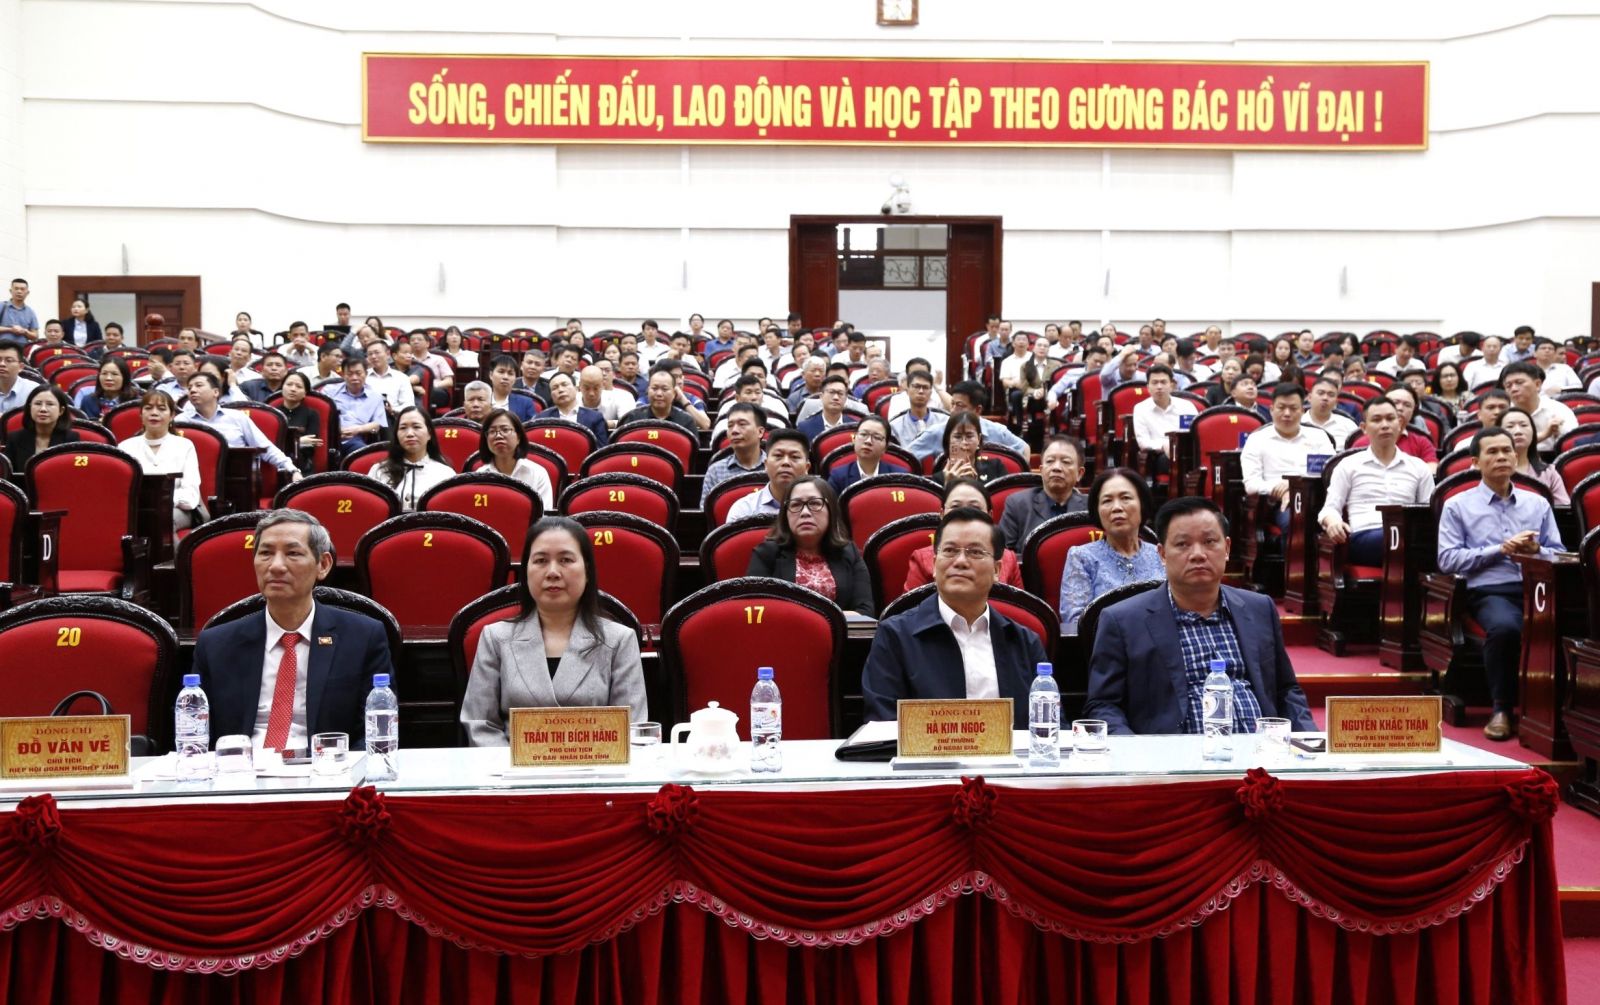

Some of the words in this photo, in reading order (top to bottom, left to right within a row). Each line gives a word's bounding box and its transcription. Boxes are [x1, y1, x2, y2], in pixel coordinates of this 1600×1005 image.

[409, 68, 496, 130] SỐNG,
[504, 69, 591, 127] CHIẾN
[598, 70, 665, 131] ĐẤU,
[673, 85, 726, 127] LAO
[734, 76, 812, 136] ĐỘNG
[820, 77, 856, 127] VÀ
[865, 86, 921, 138] HỌC
[929, 78, 983, 138] TẬP
[990, 87, 1060, 129] THEO
[1069, 84, 1164, 130] GƯƠNG
[1173, 80, 1229, 131] BÁC
[1237, 75, 1274, 132] HỒ
[1283, 81, 1311, 132] VĨ
[1317, 90, 1365, 141] ĐẠI
[1374, 90, 1383, 133] !
[444, 428, 458, 438] 22
[544, 428, 557, 439] 21
[647, 429, 659, 440] 20
[74, 455, 89, 467] 23
[474, 494, 489, 508] 21
[608, 490, 626, 503] 20
[890, 490, 905, 502] 18
[1294, 492, 1302, 514] G
[337, 500, 353, 514] 22
[423, 532, 433, 547] 2
[594, 530, 614, 546] 20
[1390, 526, 1400, 550] D
[43, 534, 51, 561] D
[1534, 582, 1546, 612] C
[744, 605, 765, 624] 17
[56, 627, 82, 647] 20
[926, 719, 939, 734] HÀ
[940, 722, 959, 734] KIM
[961, 721, 985, 735] NGỌC
[47, 738, 83, 753] VĂN
[88, 734, 110, 753] VẺ
